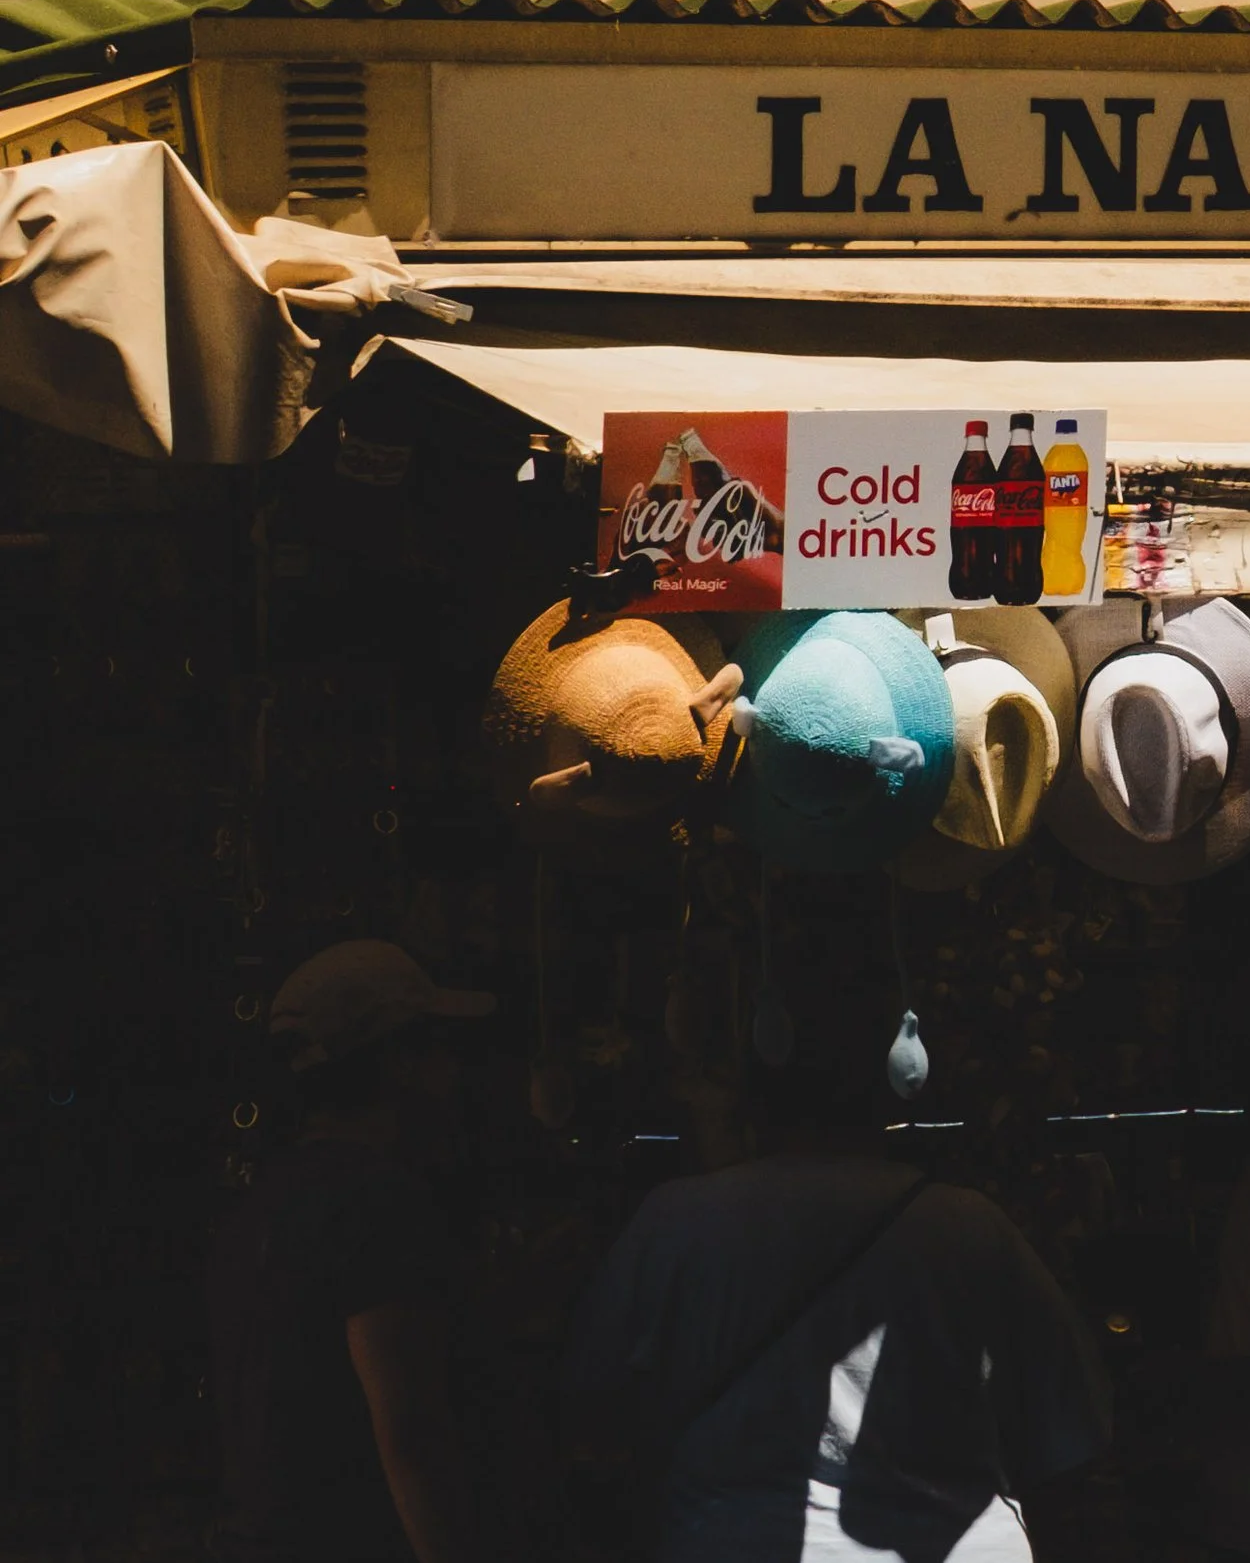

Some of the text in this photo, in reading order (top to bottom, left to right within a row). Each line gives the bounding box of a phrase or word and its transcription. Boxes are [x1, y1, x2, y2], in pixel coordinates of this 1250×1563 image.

[754, 96, 983, 213] LA
[818, 465, 921, 506] Cold
[619, 480, 766, 564] Coca-Cola
[798, 519, 937, 559] drinks
[653, 578, 727, 592] Real Magic
